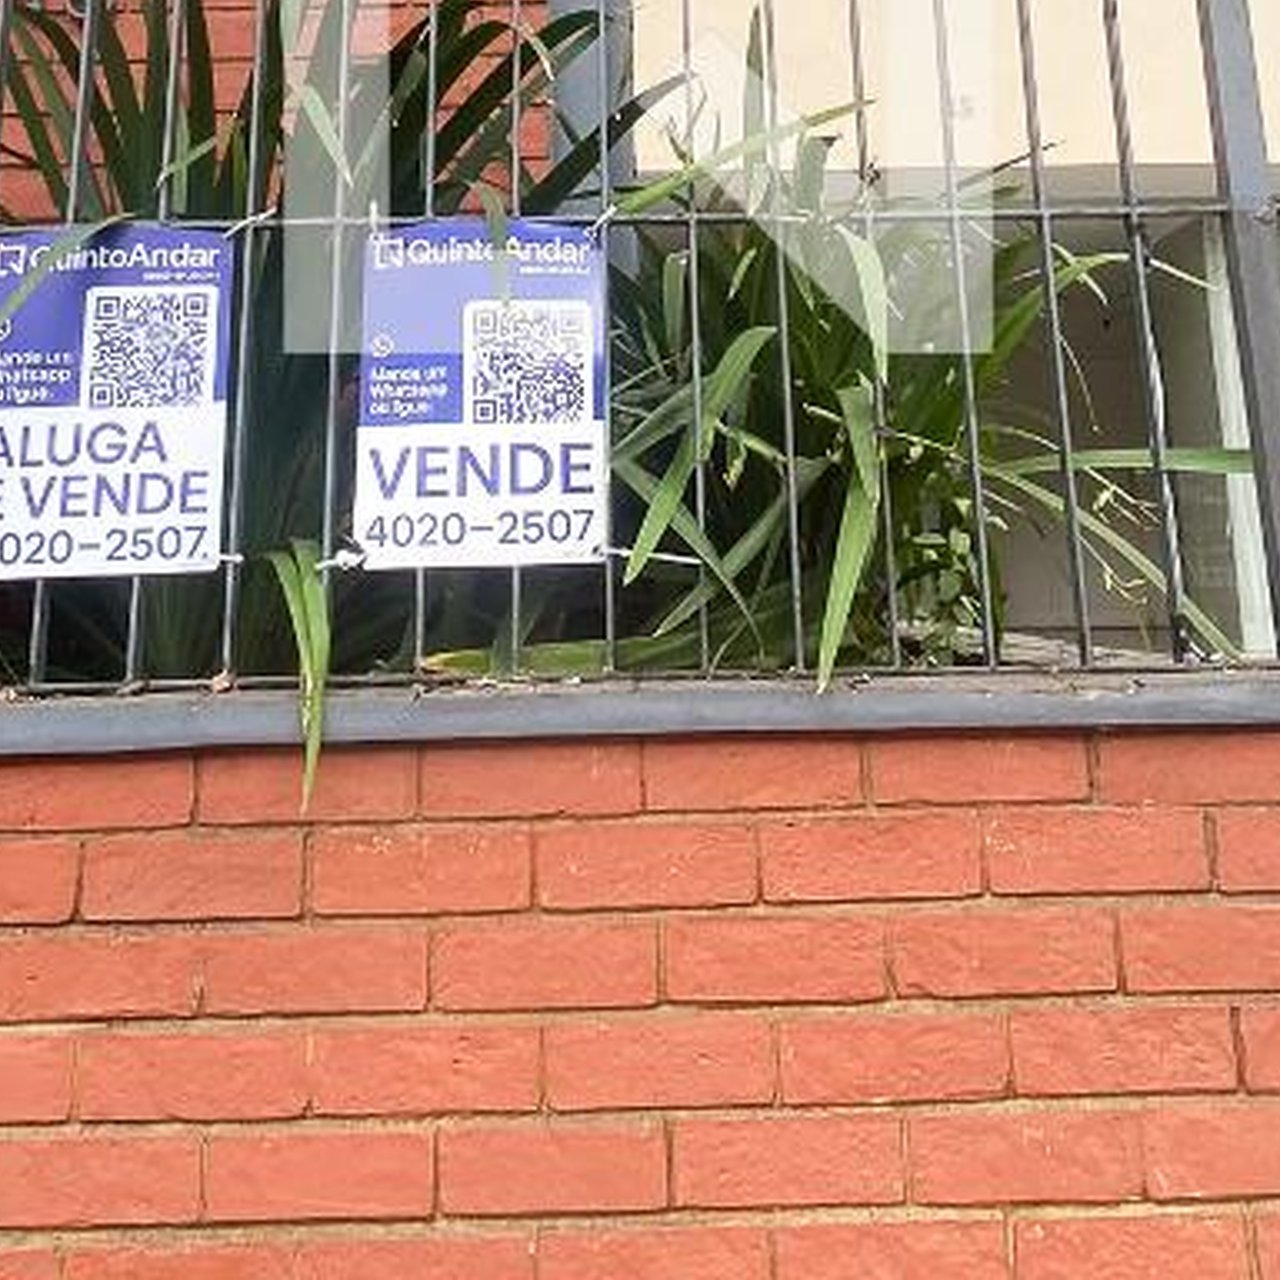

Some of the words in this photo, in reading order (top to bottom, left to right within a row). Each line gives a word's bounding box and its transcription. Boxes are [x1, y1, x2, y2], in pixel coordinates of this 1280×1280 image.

[21, 471, 209, 519] VENDE
[369, 442, 594, 500] VENDE
[366, 508, 595, 548] 4020-2507
